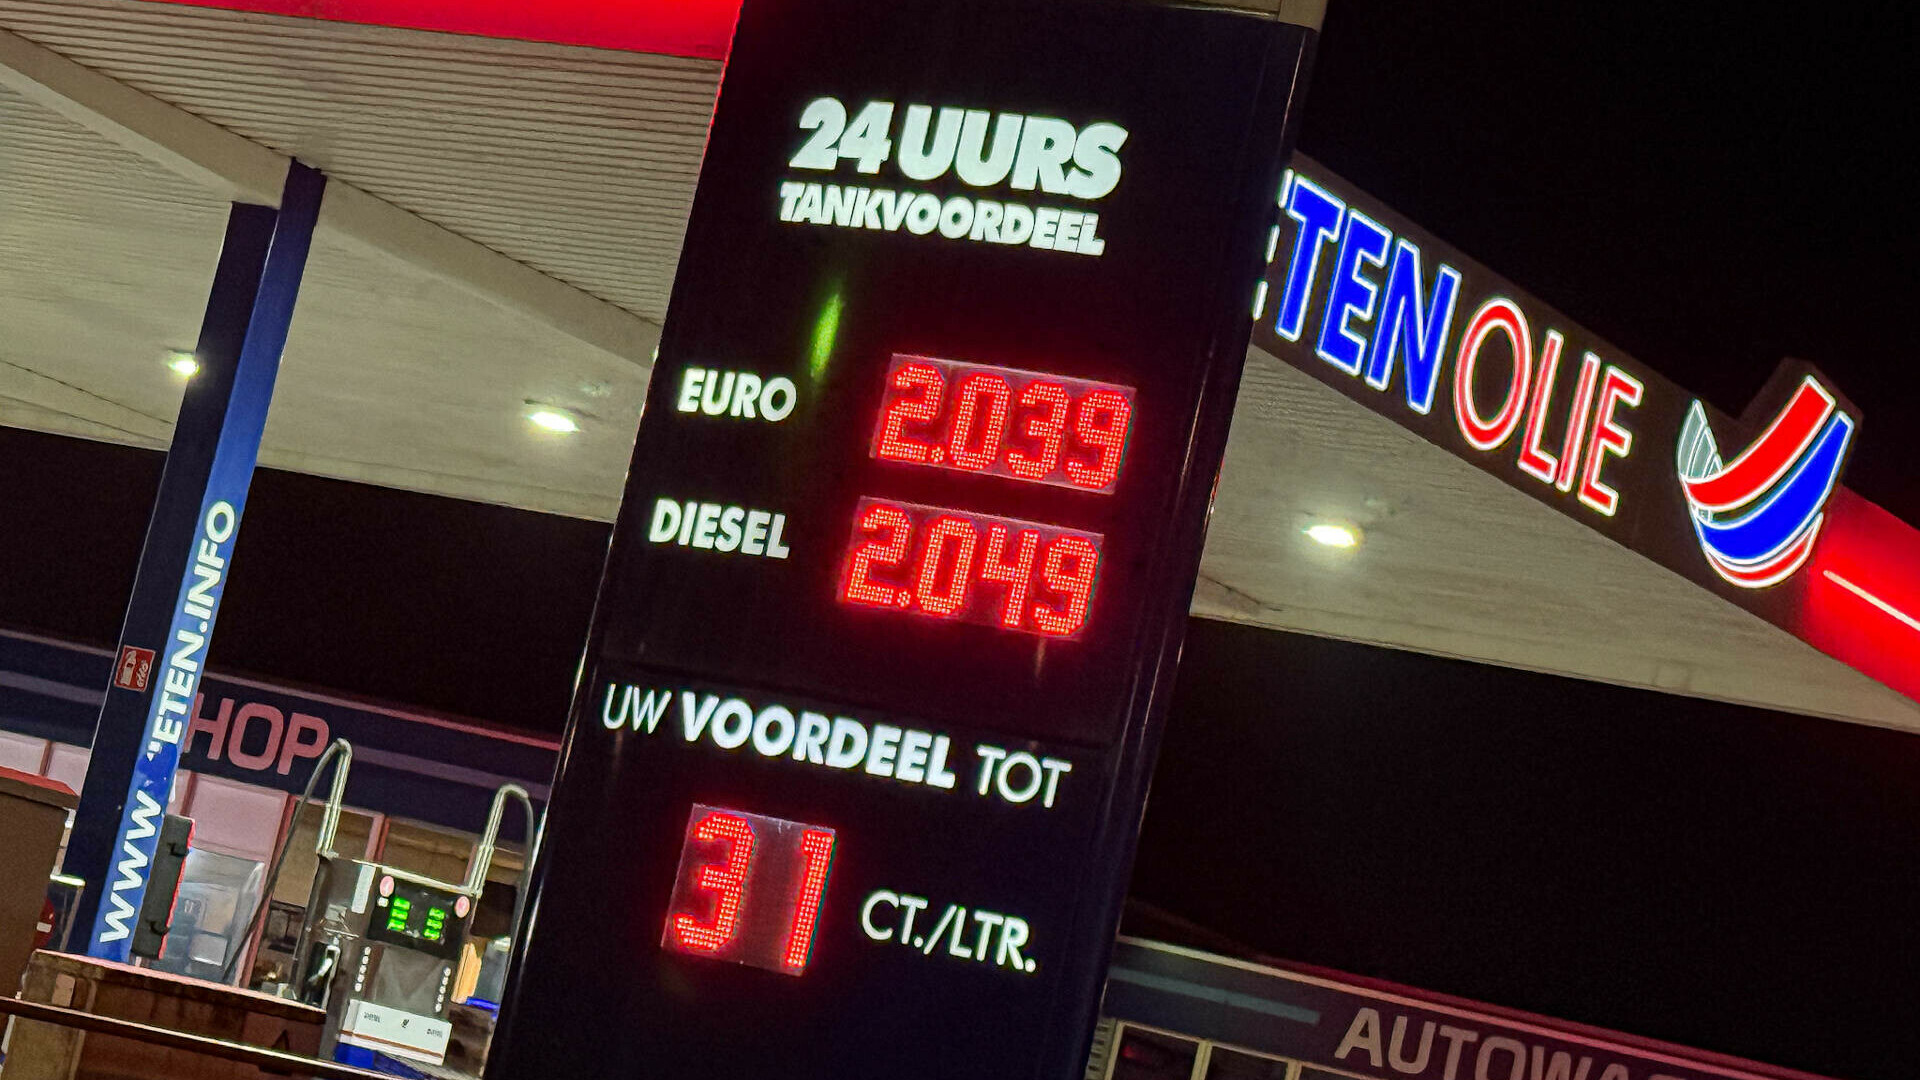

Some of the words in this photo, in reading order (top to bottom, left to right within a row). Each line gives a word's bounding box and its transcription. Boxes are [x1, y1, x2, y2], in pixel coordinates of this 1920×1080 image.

[788, 97, 895, 174] 24
[898, 104, 1128, 200] UURS
[780, 181, 1105, 256] TANKVOORDEEL
[1252, 168, 1462, 415] TEN
[1453, 297, 1644, 517] OLIE
[677, 368, 797, 422] EURO
[878, 363, 1132, 489] 2.039
[649, 498, 790, 559] DIESEL
[845, 505, 1101, 637] 2.049
[183, 692, 330, 775] HOP
[603, 683, 672, 734] UW
[682, 691, 956, 789] VOORDEEL
[976, 745, 1072, 808] TOT
[673, 812, 835, 968] 31
[862, 891, 1036, 973] CT./LTR.
[1334, 1006, 1688, 1080] AUTOW
